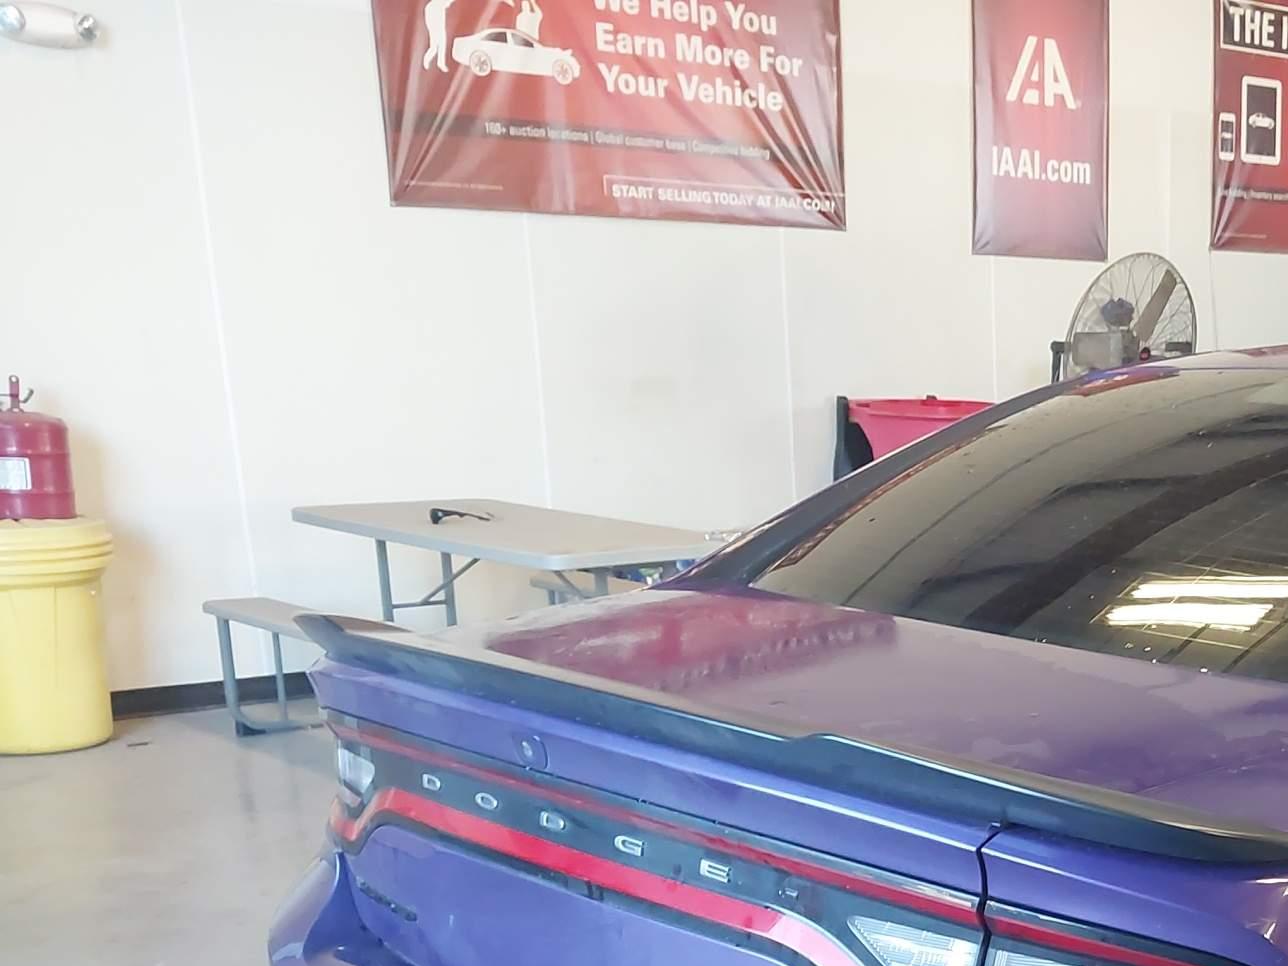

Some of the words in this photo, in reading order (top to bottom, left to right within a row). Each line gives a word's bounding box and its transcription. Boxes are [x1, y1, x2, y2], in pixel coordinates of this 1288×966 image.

[651, 0, 718, 31] Help
[724, 0, 777, 35] You
[1229, 6, 1275, 48] THE
[595, 22, 665, 58] Earn
[675, 33, 750, 69] More
[759, 45, 803, 77] For
[597, 62, 668, 98] Your
[676, 73, 784, 111] Vehicle
[992, 145, 1091, 185] IAAI.com
[612, 183, 654, 199] START
[658, 187, 710, 204] SELLING
[712, 191, 754, 206] TODAY
[756, 194, 772, 208] AT
[422, 772, 732, 884] DODGE
